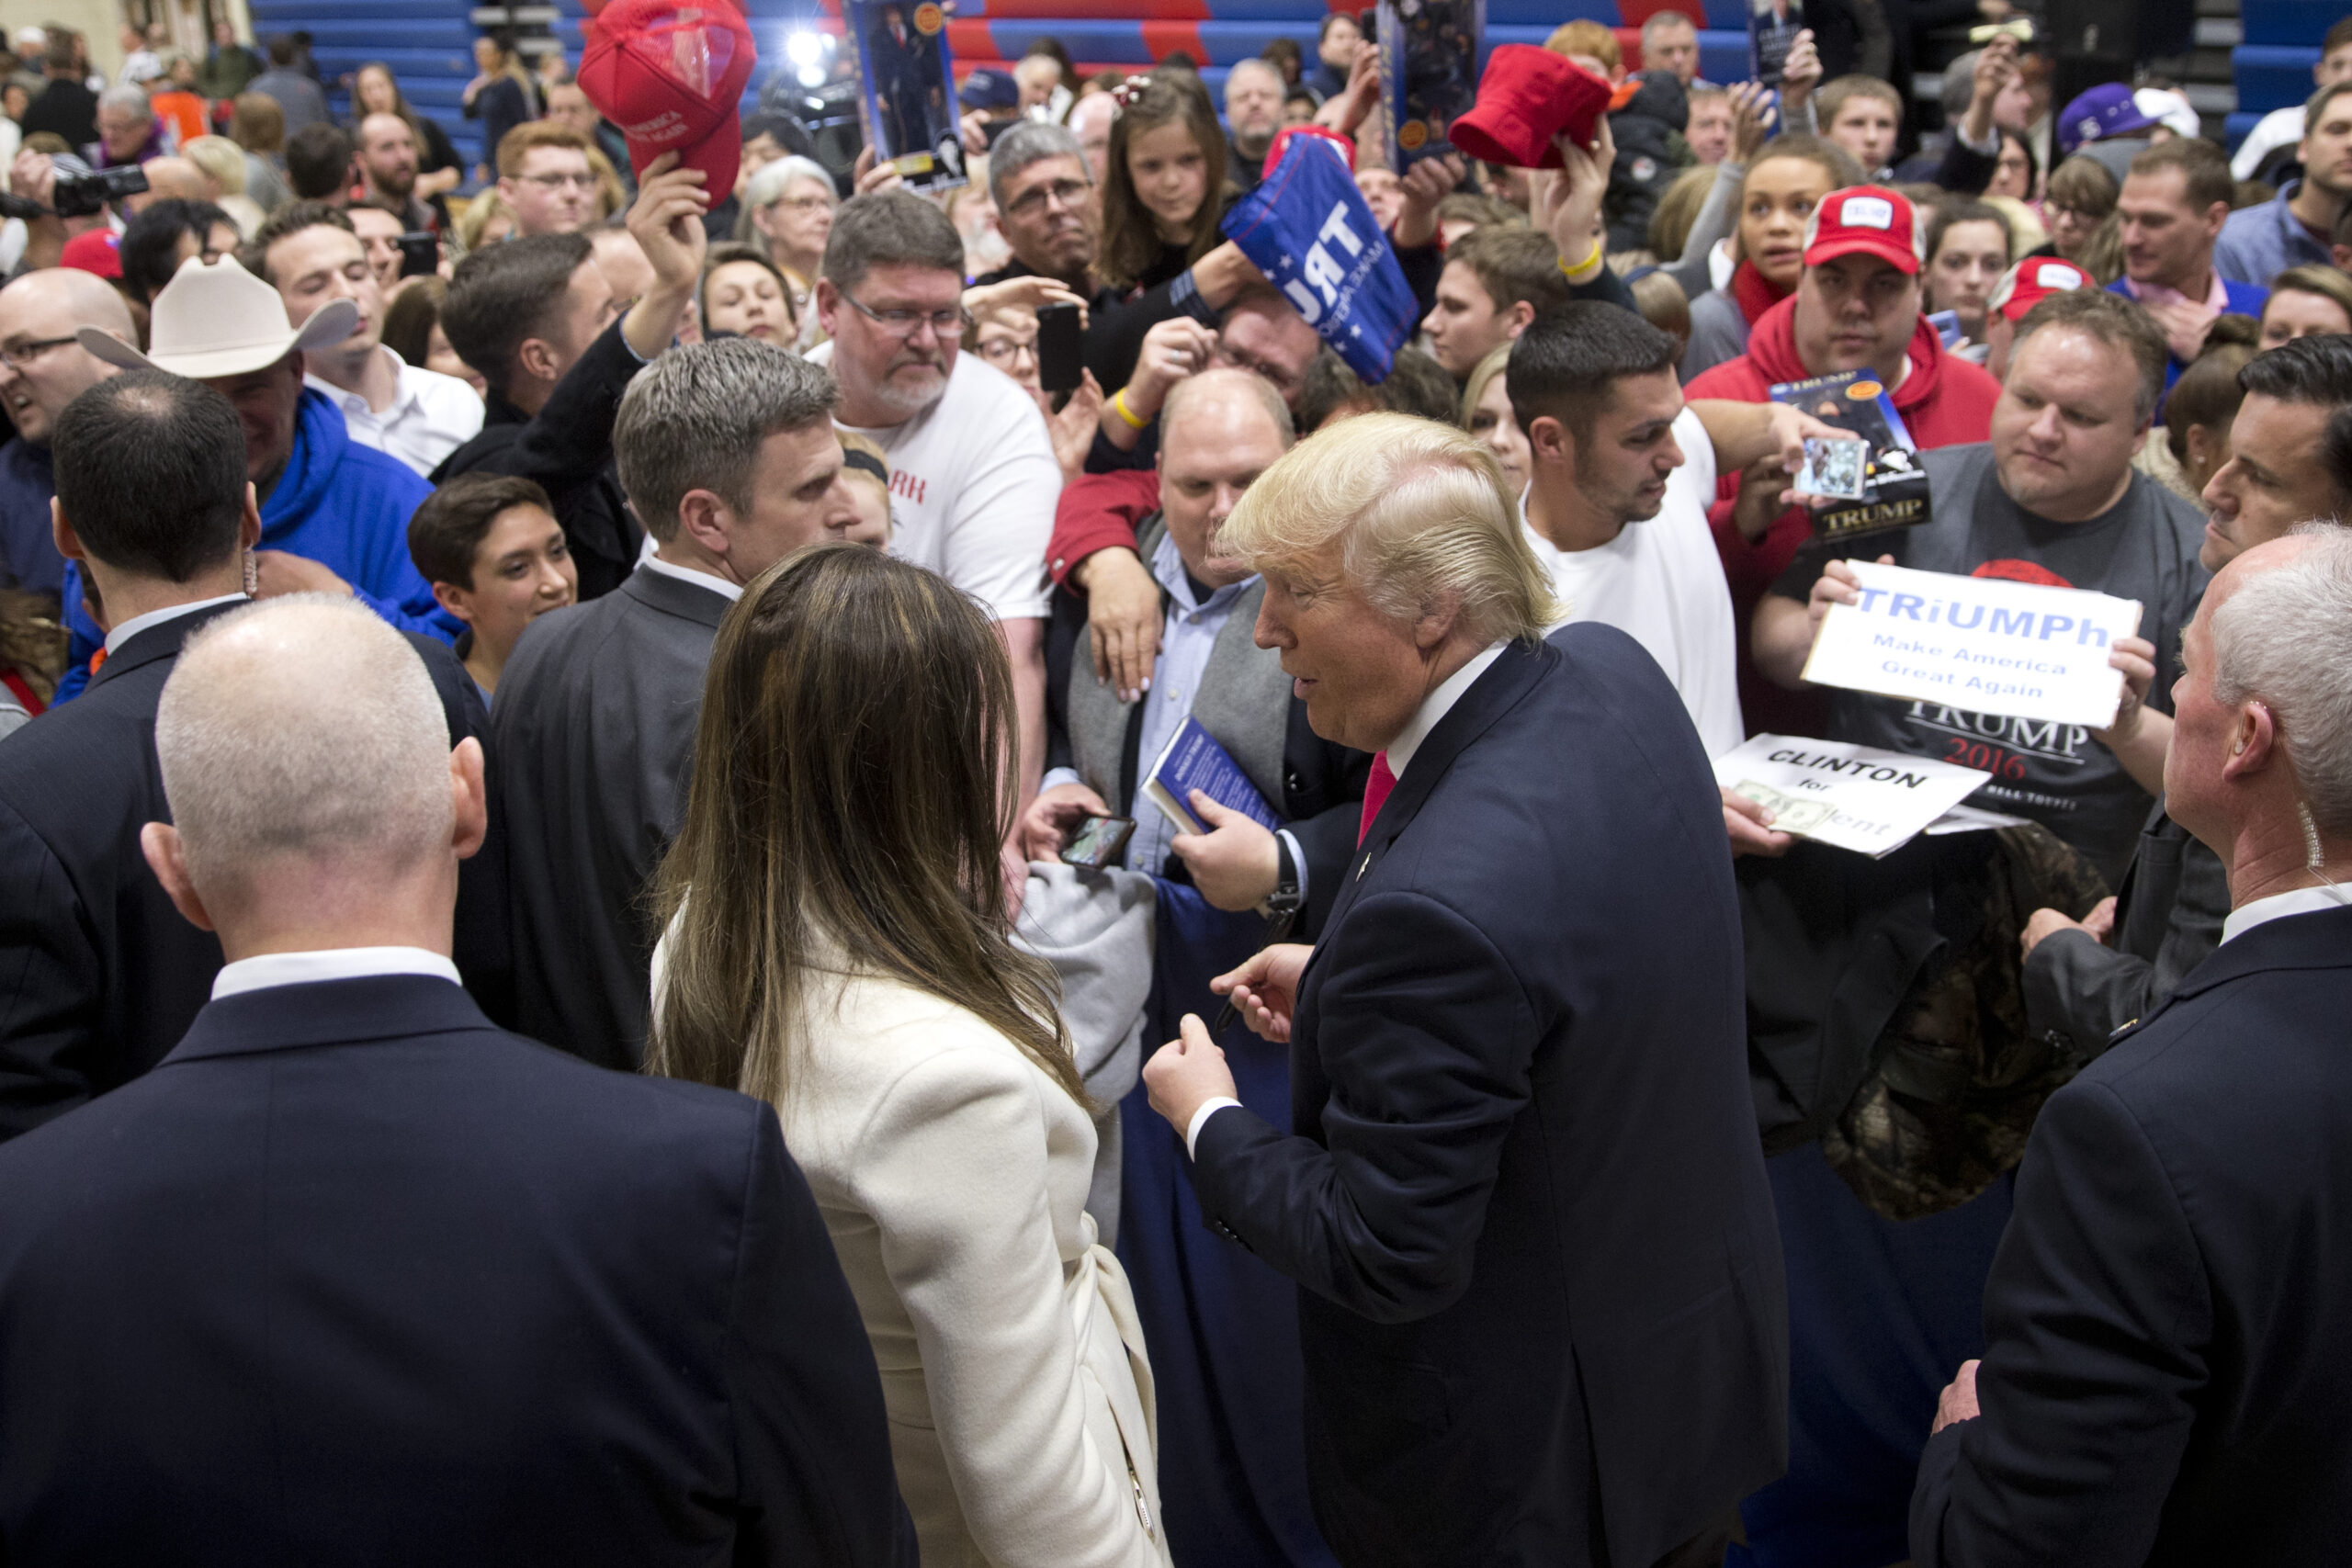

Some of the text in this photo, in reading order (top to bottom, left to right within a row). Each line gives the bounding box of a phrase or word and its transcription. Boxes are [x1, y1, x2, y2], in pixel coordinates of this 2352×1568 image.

[1823, 499, 1923, 530] TRUMP
[1873, 634, 2067, 675] Make America
[1882, 660, 2043, 698] Great Again
[1768, 750, 1929, 789] CLINTON
[1943, 738, 2026, 781] 2016
[1798, 778, 1834, 792] for
[1832, 809, 1893, 835] ent
